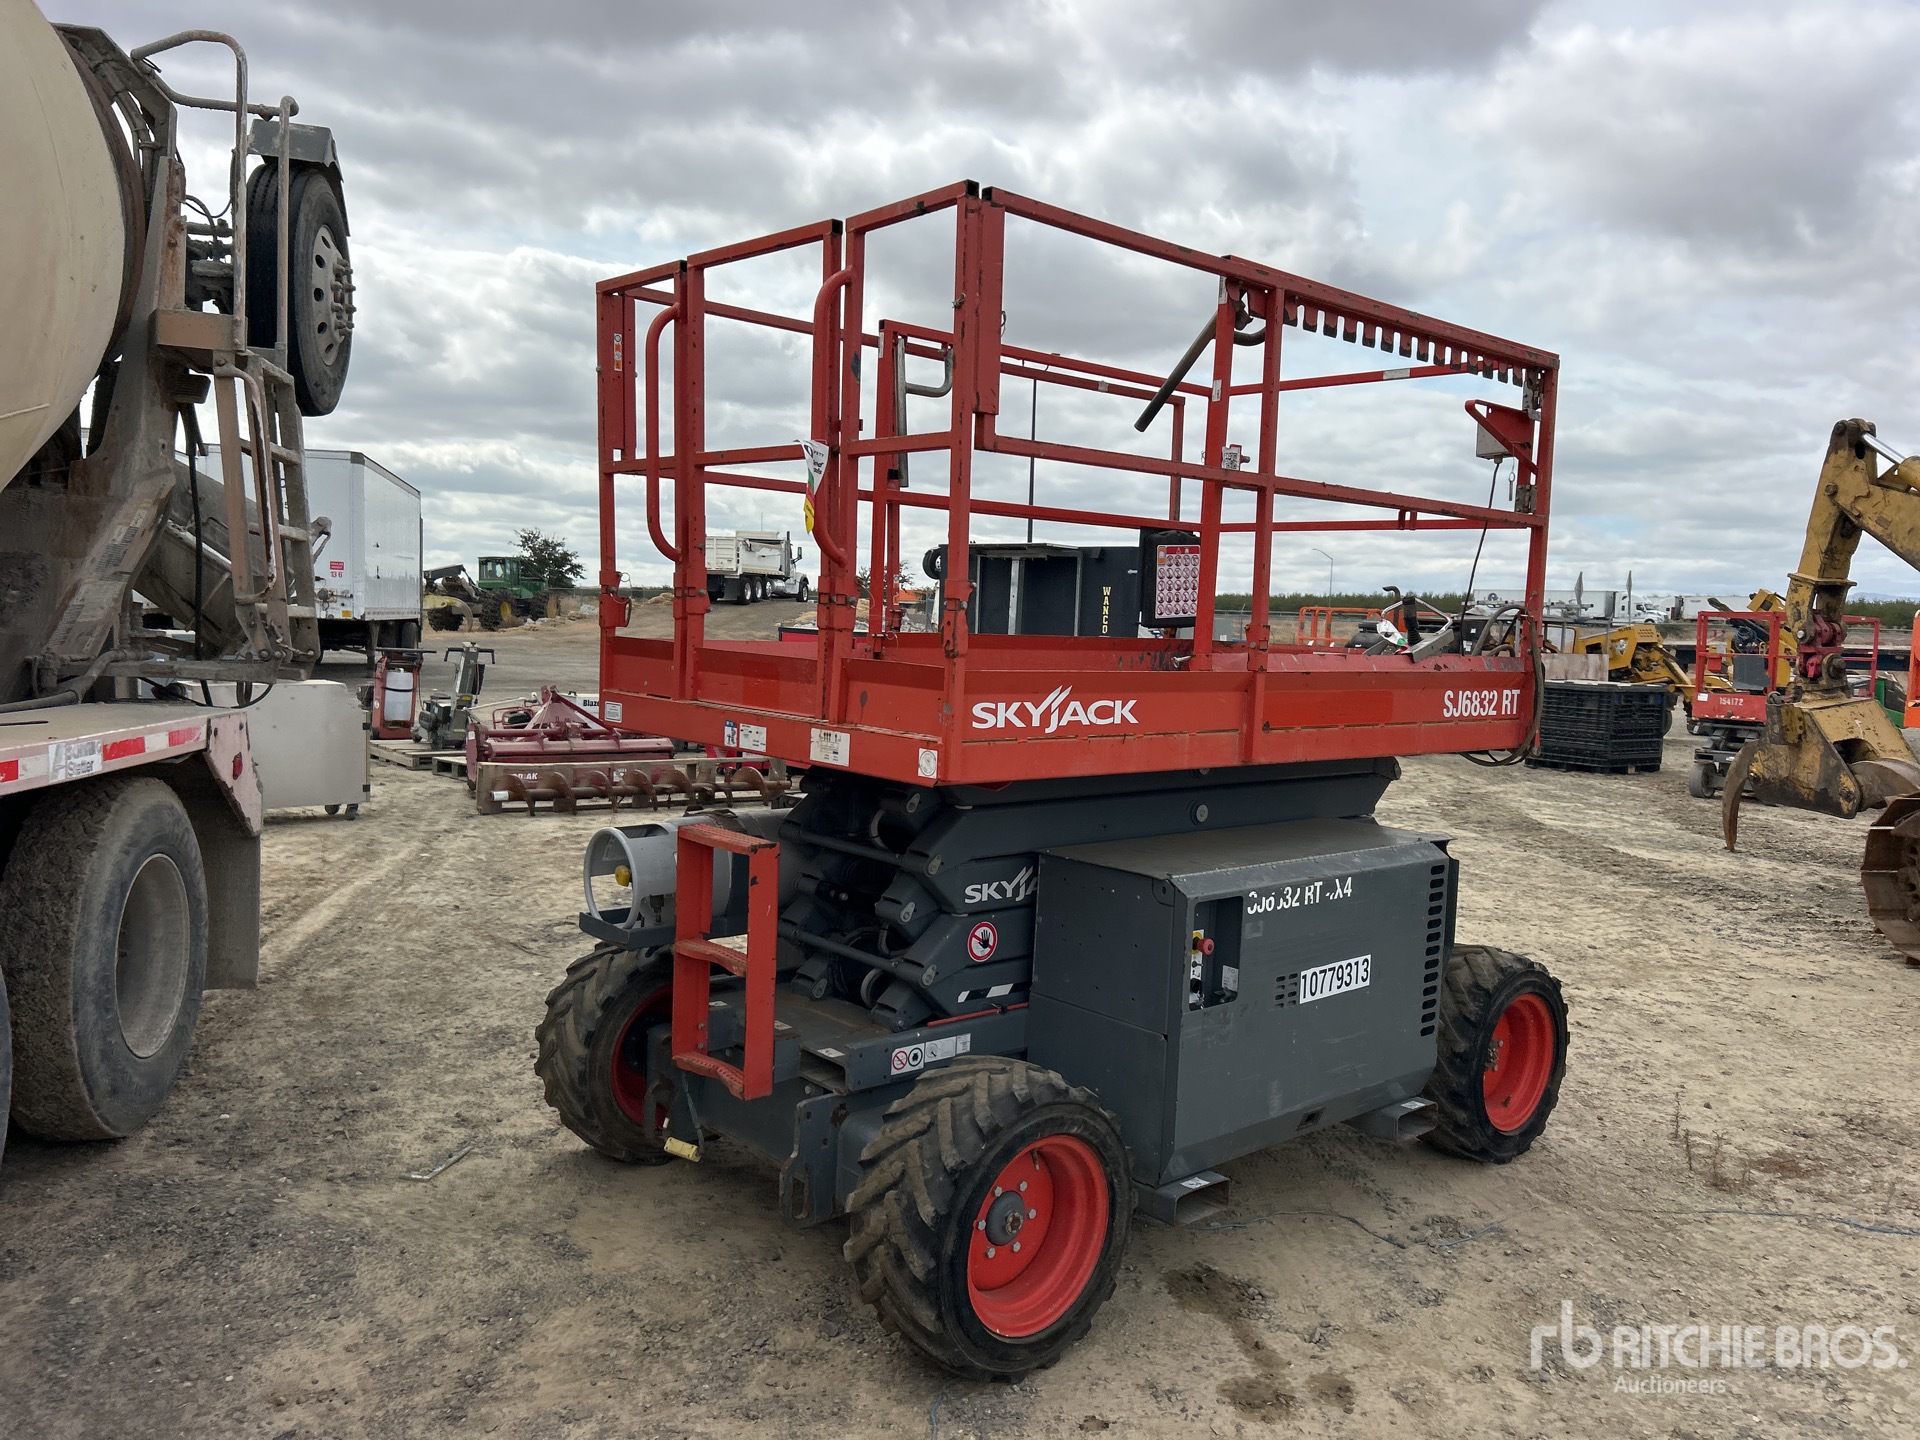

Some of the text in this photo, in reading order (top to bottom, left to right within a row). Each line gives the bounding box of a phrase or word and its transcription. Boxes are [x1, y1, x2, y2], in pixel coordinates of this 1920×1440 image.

[1102, 586, 1111, 634] WANCO
[971, 685, 1139, 734] SKYJACK
[1443, 689, 1521, 718] SJ6832 RT
[1719, 697, 1744, 706] 154172
[1304, 881, 1323, 906] RT
[1301, 958, 1370, 999] 10779313
